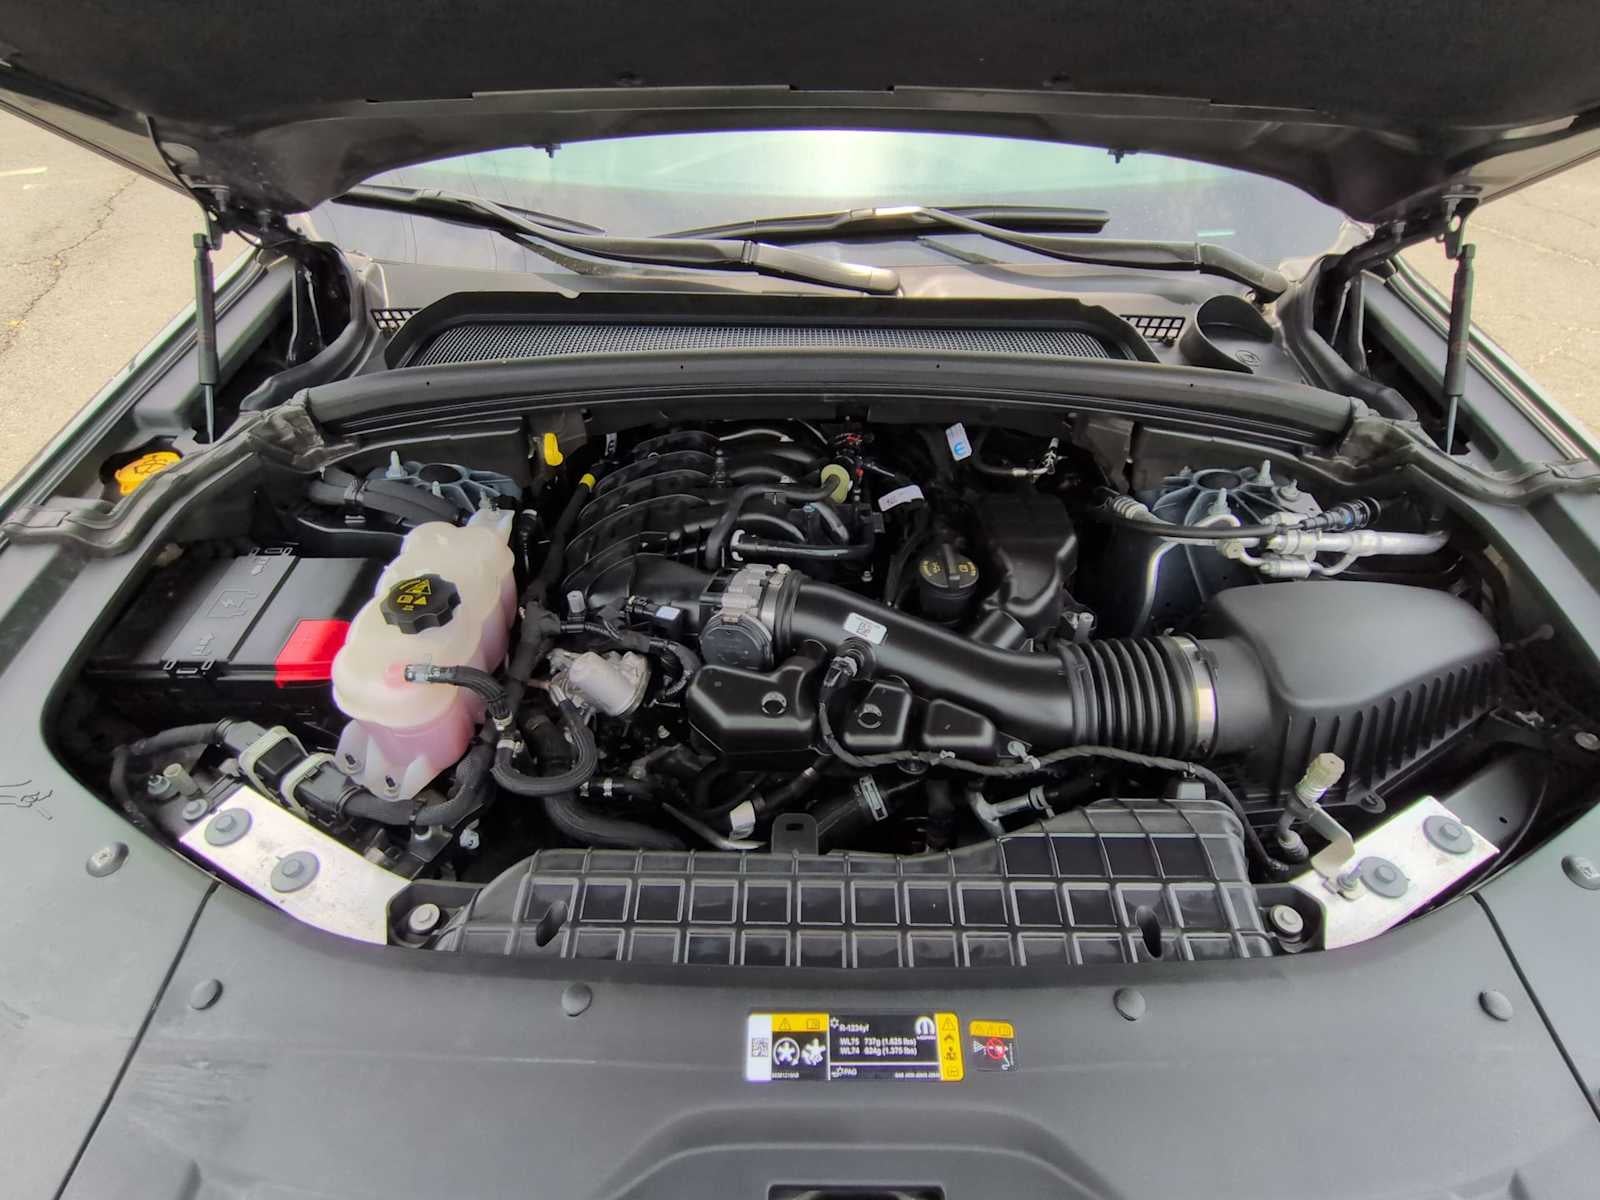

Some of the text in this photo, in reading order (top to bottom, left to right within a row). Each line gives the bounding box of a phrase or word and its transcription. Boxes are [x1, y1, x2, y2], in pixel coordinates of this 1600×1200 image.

[839, 1037, 860, 1046] WL75
[864, 1037, 881, 1047] 737g
[903, 1037, 917, 1047] lbs)
[904, 1046, 918, 1056] lbs)
